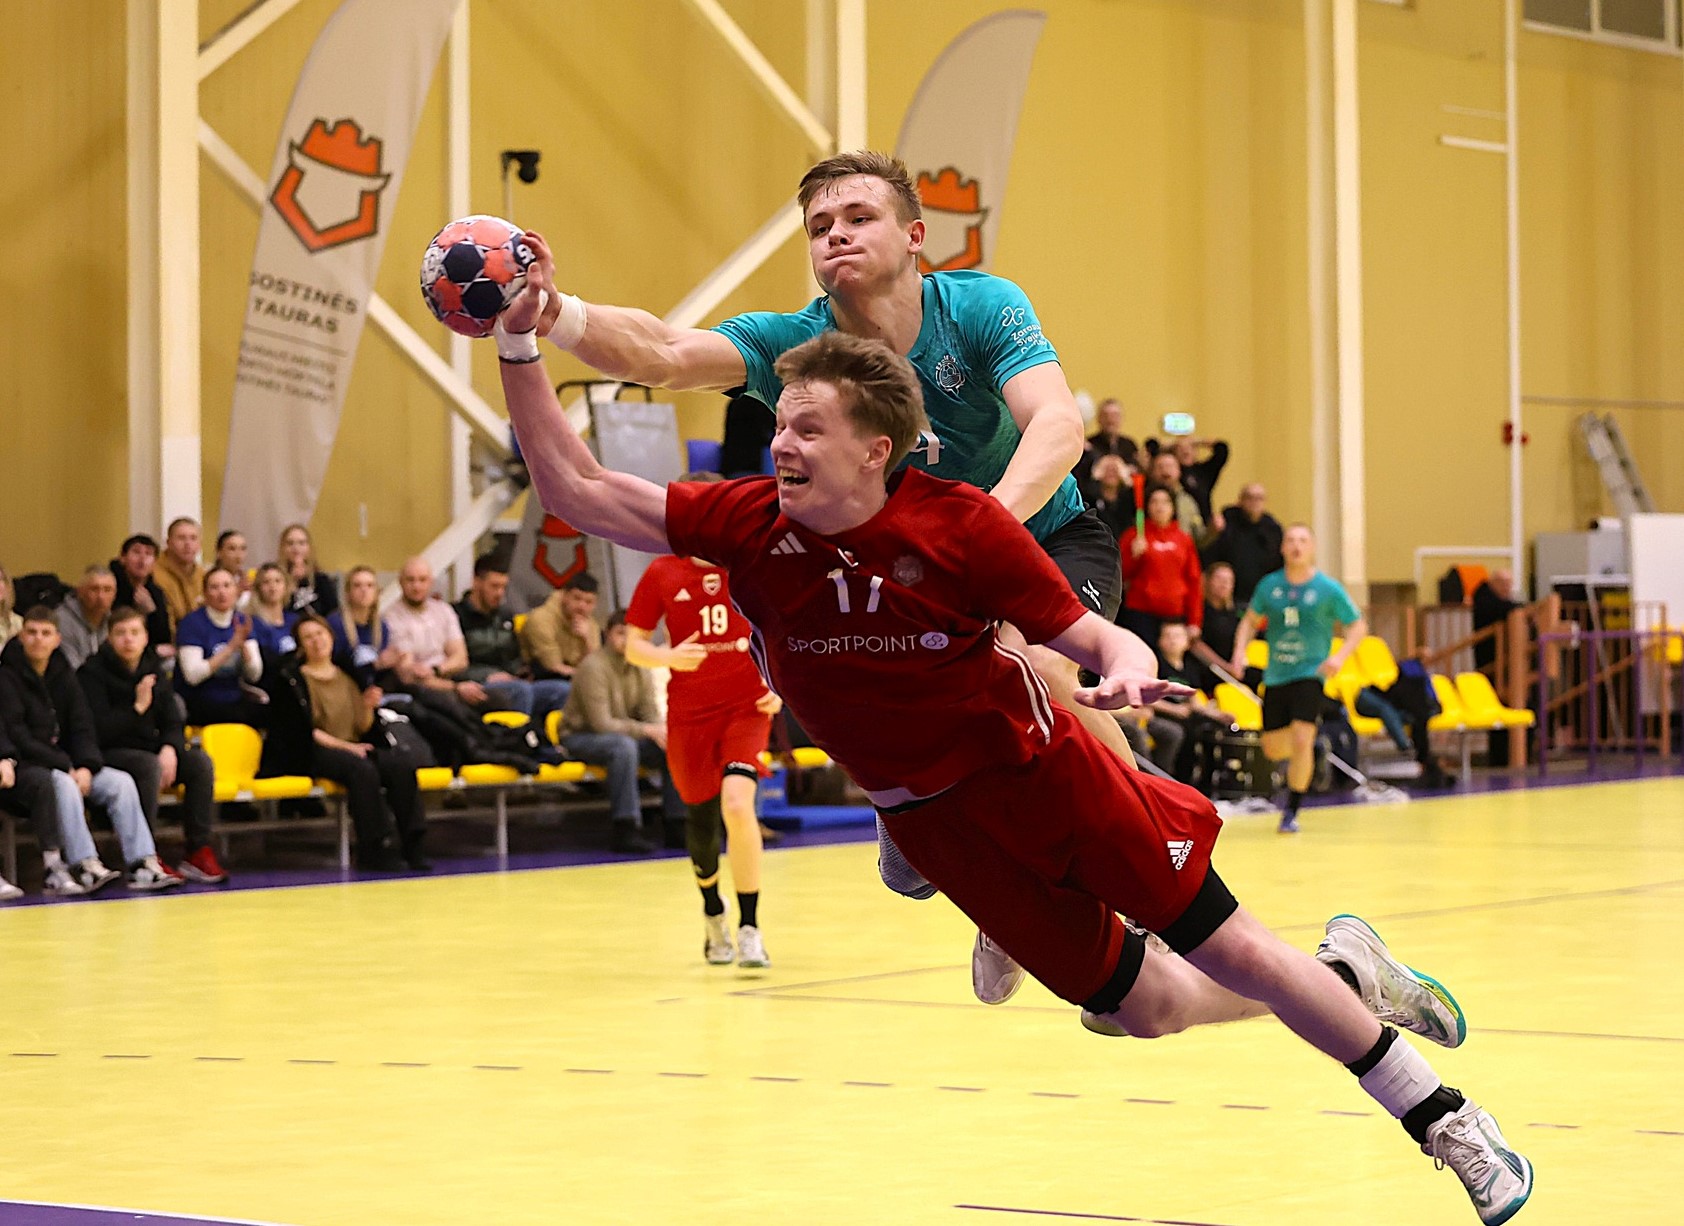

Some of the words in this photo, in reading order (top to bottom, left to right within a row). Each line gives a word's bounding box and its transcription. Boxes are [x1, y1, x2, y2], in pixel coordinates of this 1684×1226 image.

[255, 297, 338, 334] TAURAS
[699, 603, 728, 636] 19
[787, 634, 918, 654] SPORTPOINT
[1175, 839, 1194, 870] adidas
